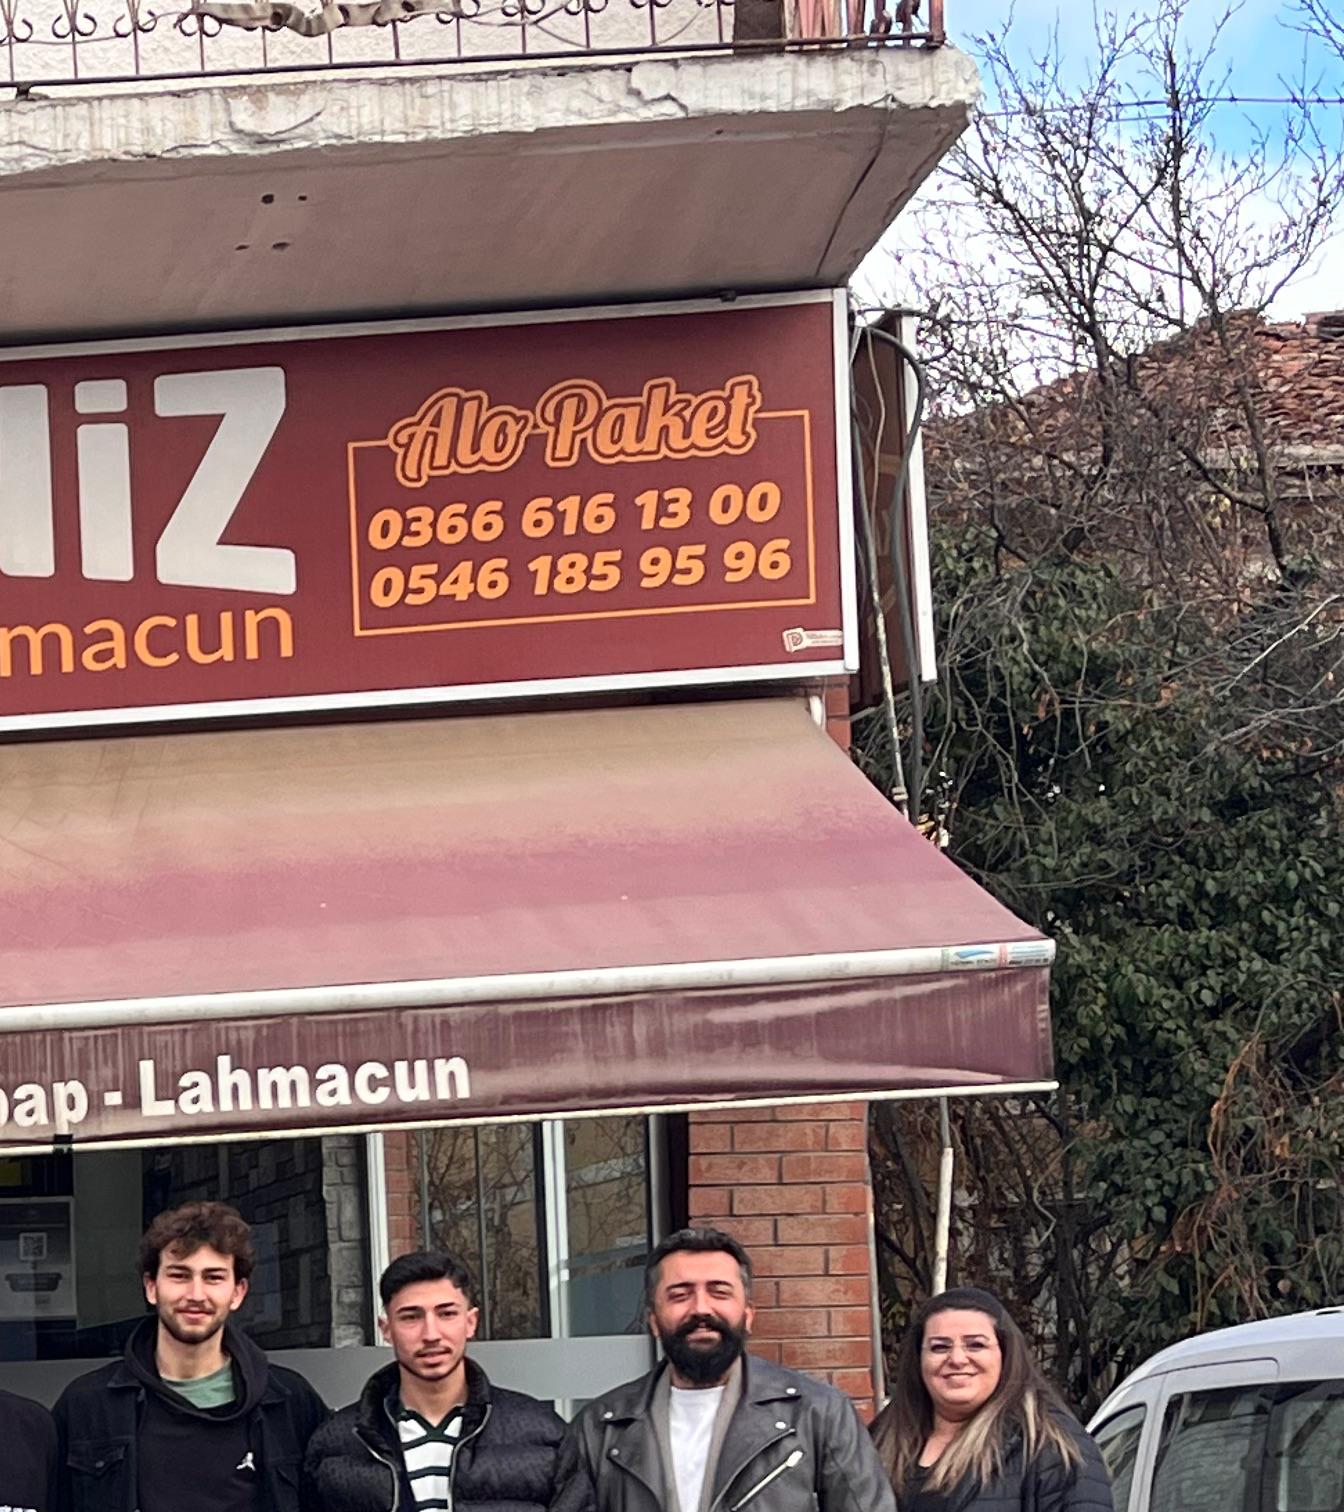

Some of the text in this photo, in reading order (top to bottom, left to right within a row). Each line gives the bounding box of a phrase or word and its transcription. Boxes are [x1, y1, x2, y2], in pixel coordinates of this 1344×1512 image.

[389, 375, 761, 488] Alo Paket
[368, 481, 781, 550] 0366 616 13 00
[370, 539, 791, 608] 0546 185 95 96
[139, 1051, 470, 1116] Lahmacun
